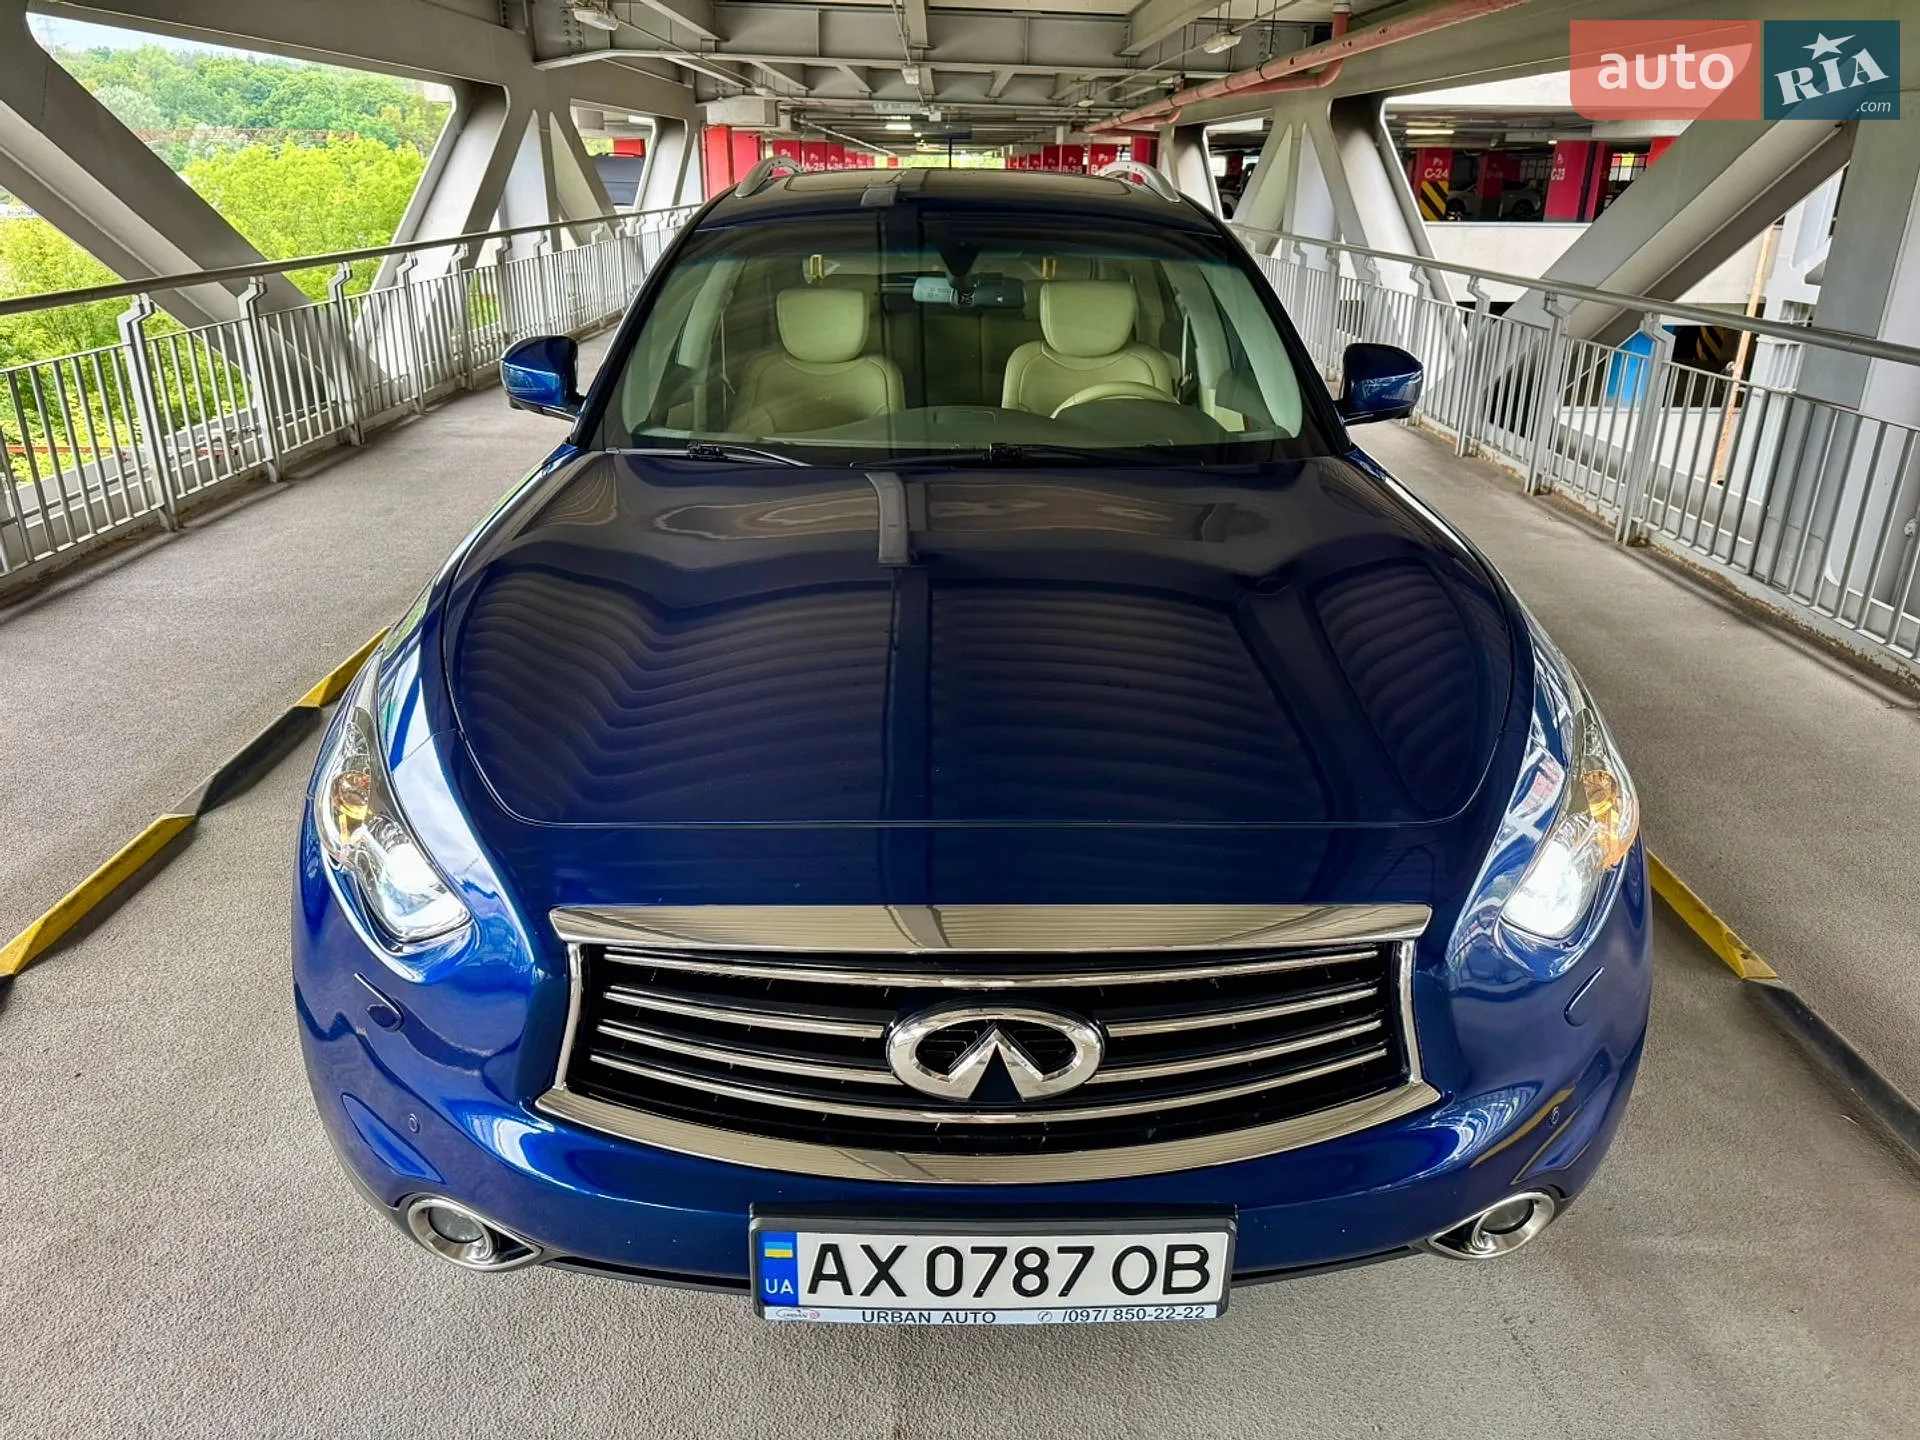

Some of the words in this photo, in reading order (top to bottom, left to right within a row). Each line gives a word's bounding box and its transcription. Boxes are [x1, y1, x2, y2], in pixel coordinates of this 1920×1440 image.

[1424, 168, 1448, 179] C-24
[807, 1243, 907, 1298] AX
[926, 1246, 1095, 1298] 0787
[1112, 1244, 1209, 1296] OB
[765, 1279, 794, 1294] UA
[862, 1310, 931, 1324] URBAN
[942, 1310, 996, 1324] AUTO
[1113, 1306, 1205, 1320] 850-22-22
